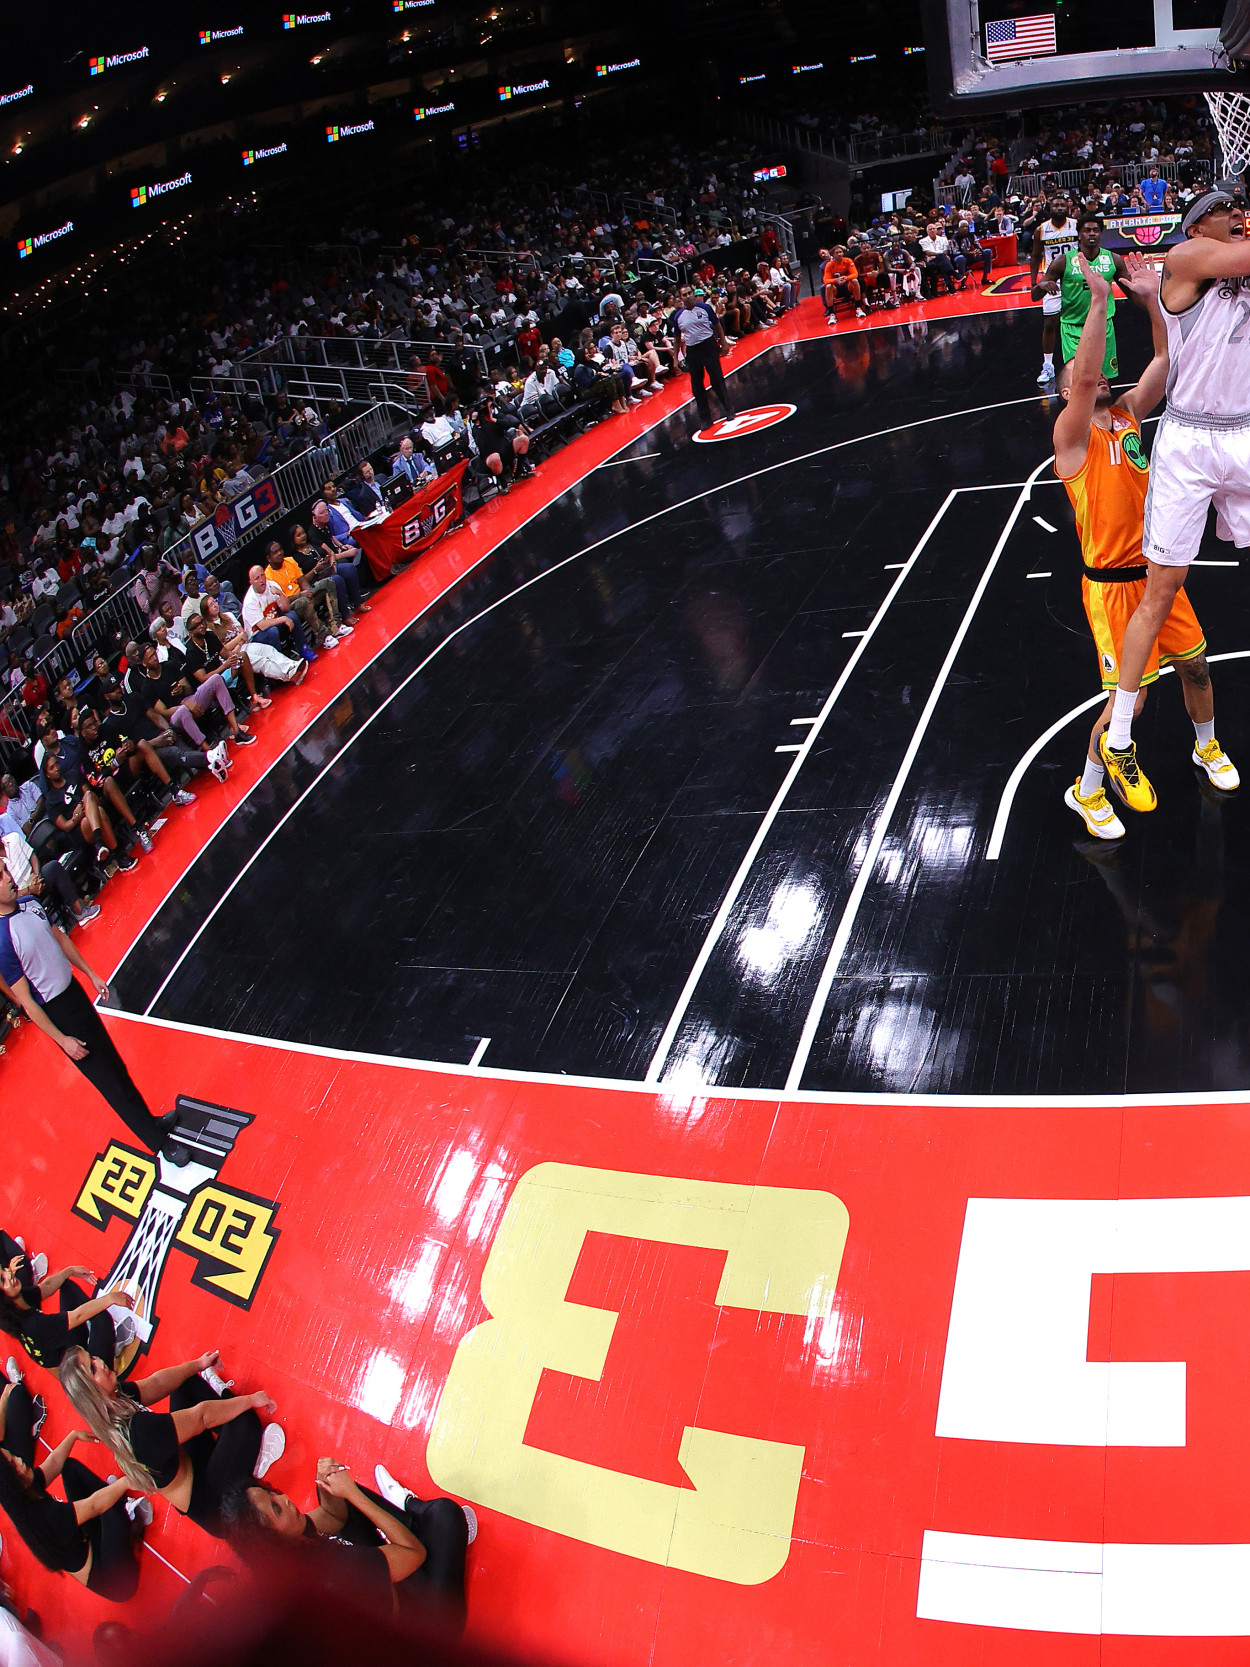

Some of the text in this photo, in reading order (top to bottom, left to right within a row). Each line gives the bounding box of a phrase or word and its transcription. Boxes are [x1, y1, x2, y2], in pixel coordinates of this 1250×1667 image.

[296, 11, 331, 25] Microsoft
[211, 25, 244, 40] Microsoft
[106, 46, 150, 68] Microsoft
[607, 58, 641, 73] Microsoft
[801, 62, 824, 72] Microsoft
[513, 79, 550, 96] Microsoft
[425, 102, 455, 116] Microsoft
[340, 119, 375, 137] Microsoft
[254, 142, 288, 160] Microsoft
[147, 172, 193, 198] Microsoft
[1109, 216, 1153, 229] ATLANTA
[33, 221, 74, 249] Microsoft
